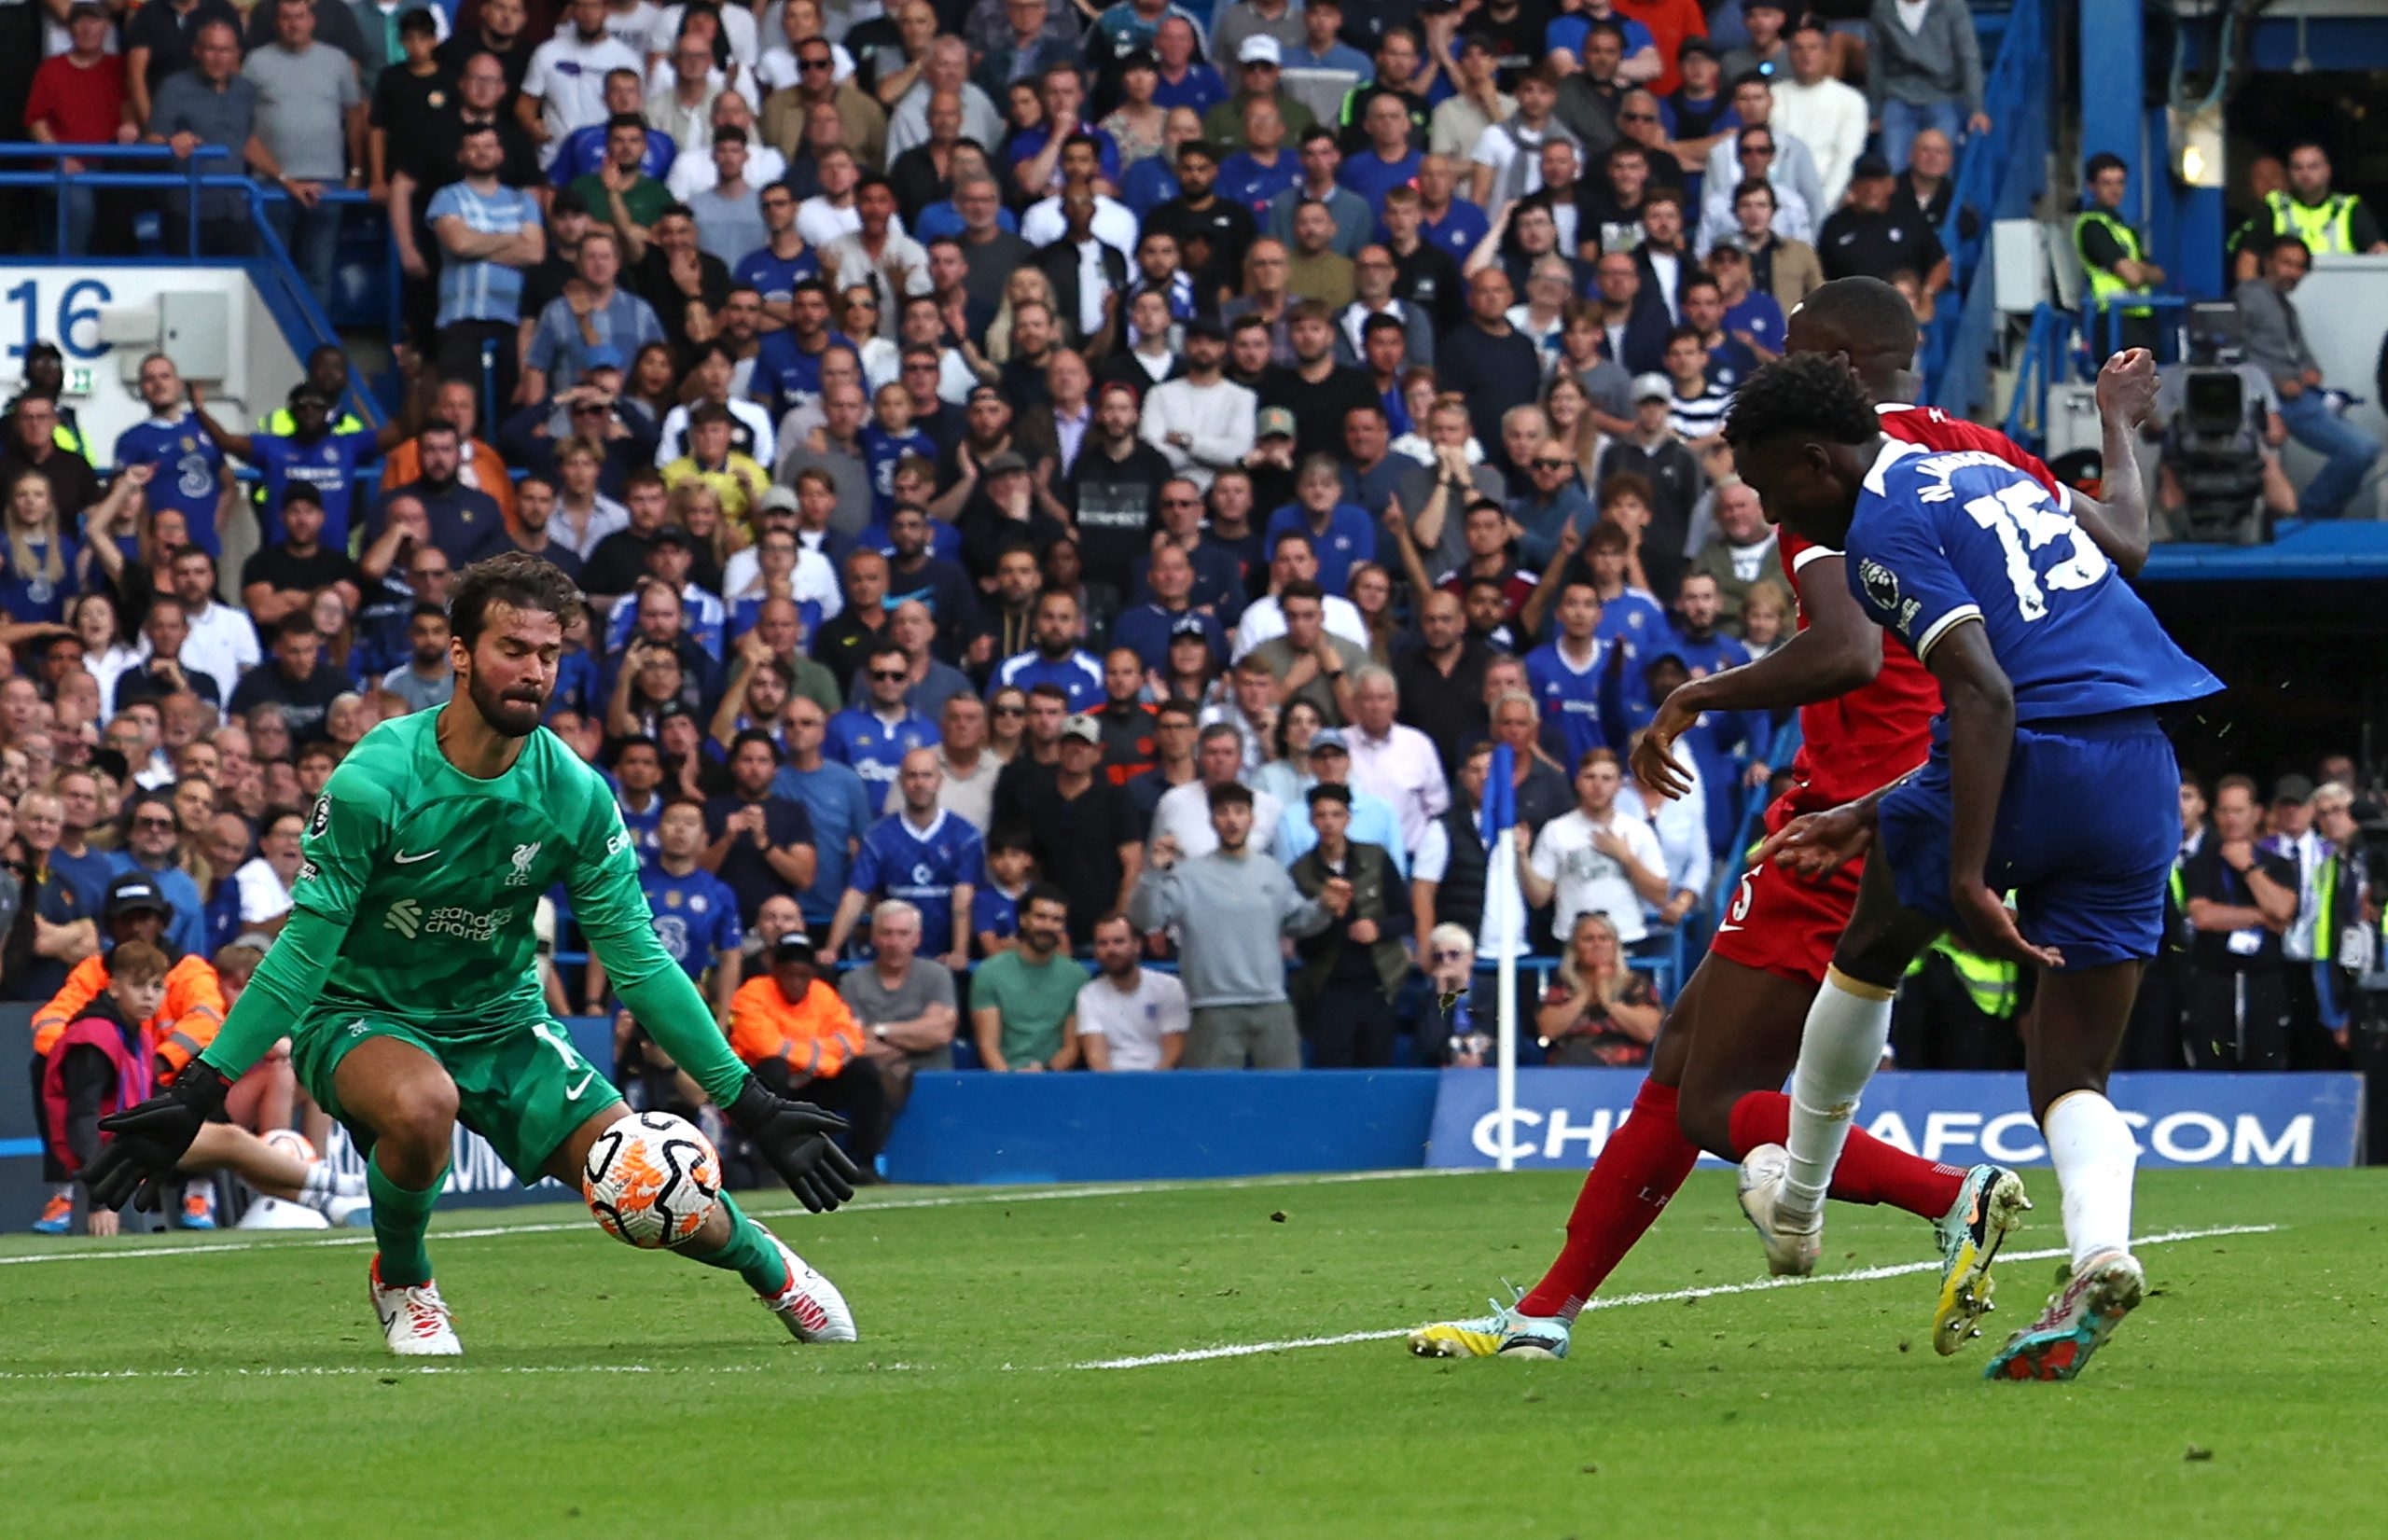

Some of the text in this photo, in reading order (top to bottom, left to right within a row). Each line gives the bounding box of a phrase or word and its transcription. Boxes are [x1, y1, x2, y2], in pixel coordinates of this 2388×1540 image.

[7, 279, 113, 360] 16
[1964, 479, 2108, 622] 15
[1732, 864, 1764, 922] 5
[531, 1023, 578, 1070] 1
